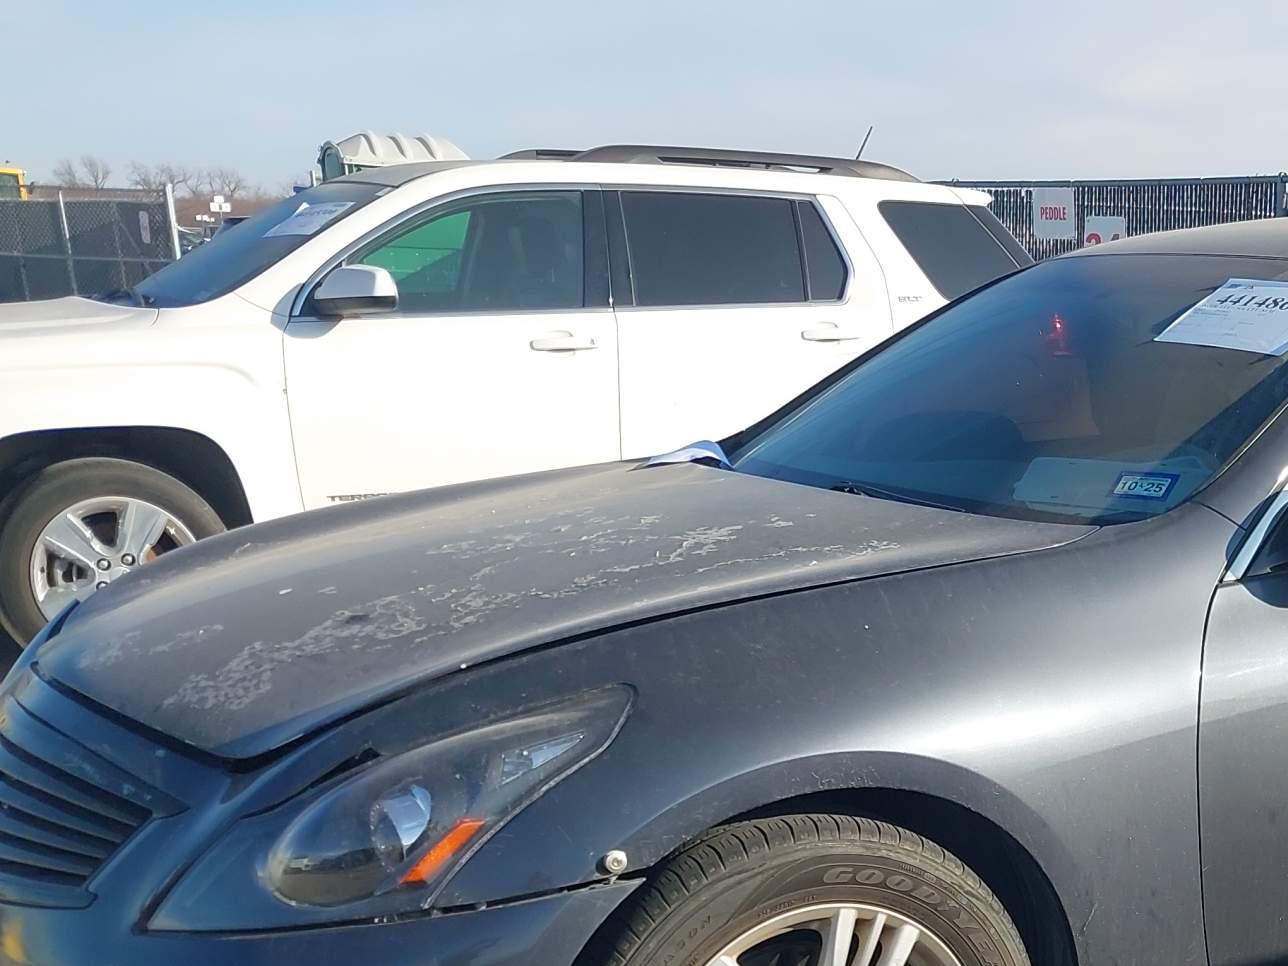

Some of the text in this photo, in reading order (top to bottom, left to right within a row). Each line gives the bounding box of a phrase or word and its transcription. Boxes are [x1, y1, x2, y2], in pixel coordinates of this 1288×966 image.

[1040, 206, 1067, 221] PEDDLE
[1119, 480, 1166, 493] 10 25
